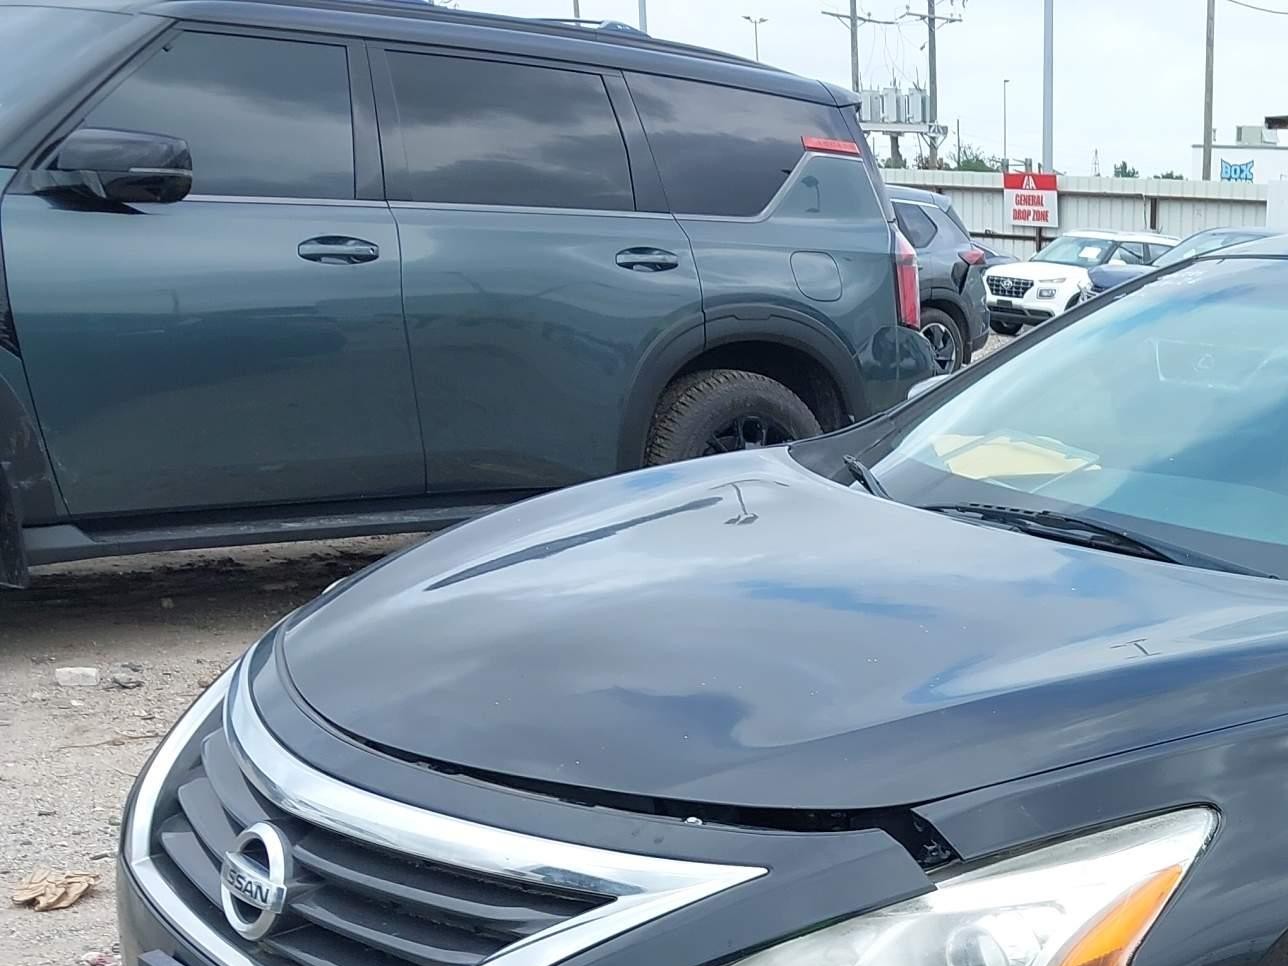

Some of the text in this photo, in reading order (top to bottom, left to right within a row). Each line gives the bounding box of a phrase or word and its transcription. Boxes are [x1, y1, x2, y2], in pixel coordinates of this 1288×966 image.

[1221, 158, 1254, 180] BOX
[1015, 194, 1044, 207] GENERAL
[1012, 208, 1049, 223] DROP ZONE
